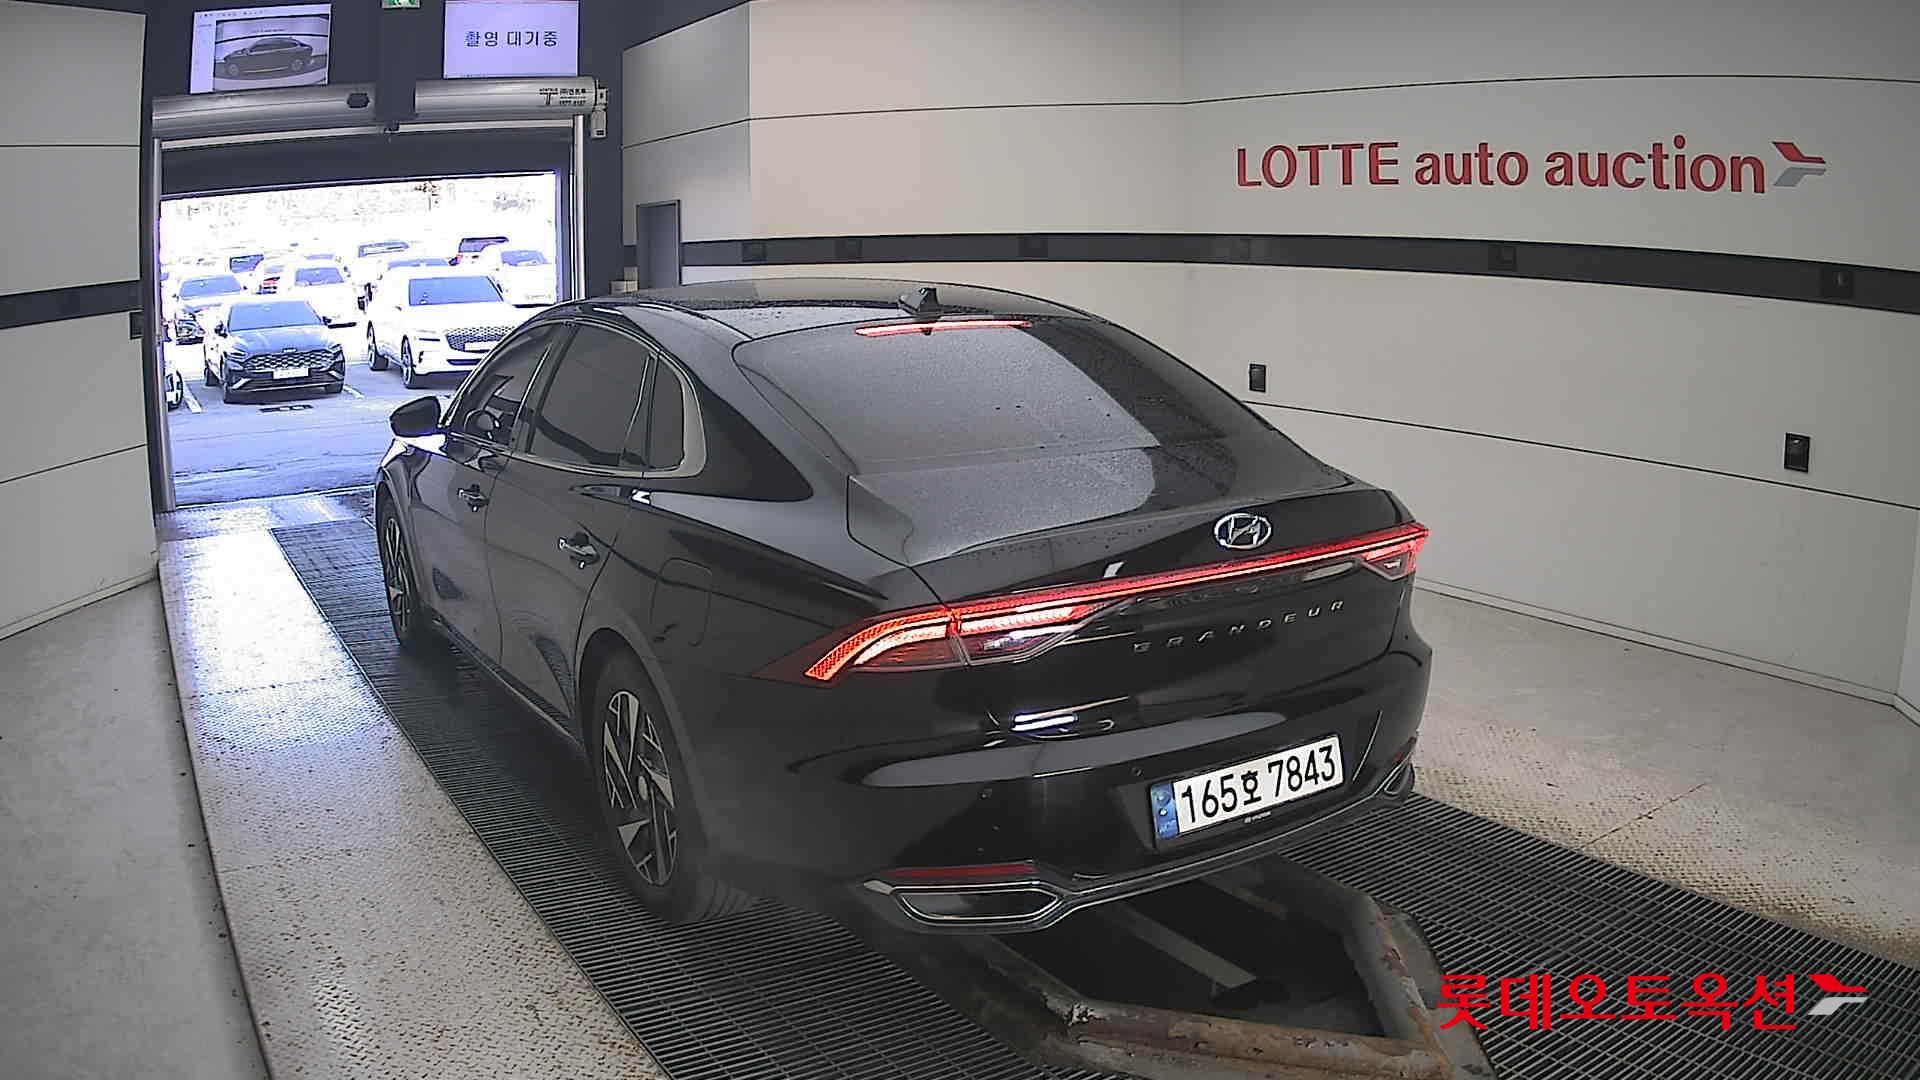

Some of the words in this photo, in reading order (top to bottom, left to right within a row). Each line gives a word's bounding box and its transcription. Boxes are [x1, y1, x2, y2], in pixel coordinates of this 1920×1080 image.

[465, 31, 498, 48] 촬영
[507, 31, 558, 48] 대기중
[1237, 143, 1398, 188] LOTTE
[1414, 143, 1529, 186] auto
[1545, 135, 1766, 193] auction
[1134, 600, 1344, 653] GRANDEUR
[1181, 770, 1262, 823] 165호
[1267, 745, 1336, 798] 7843
